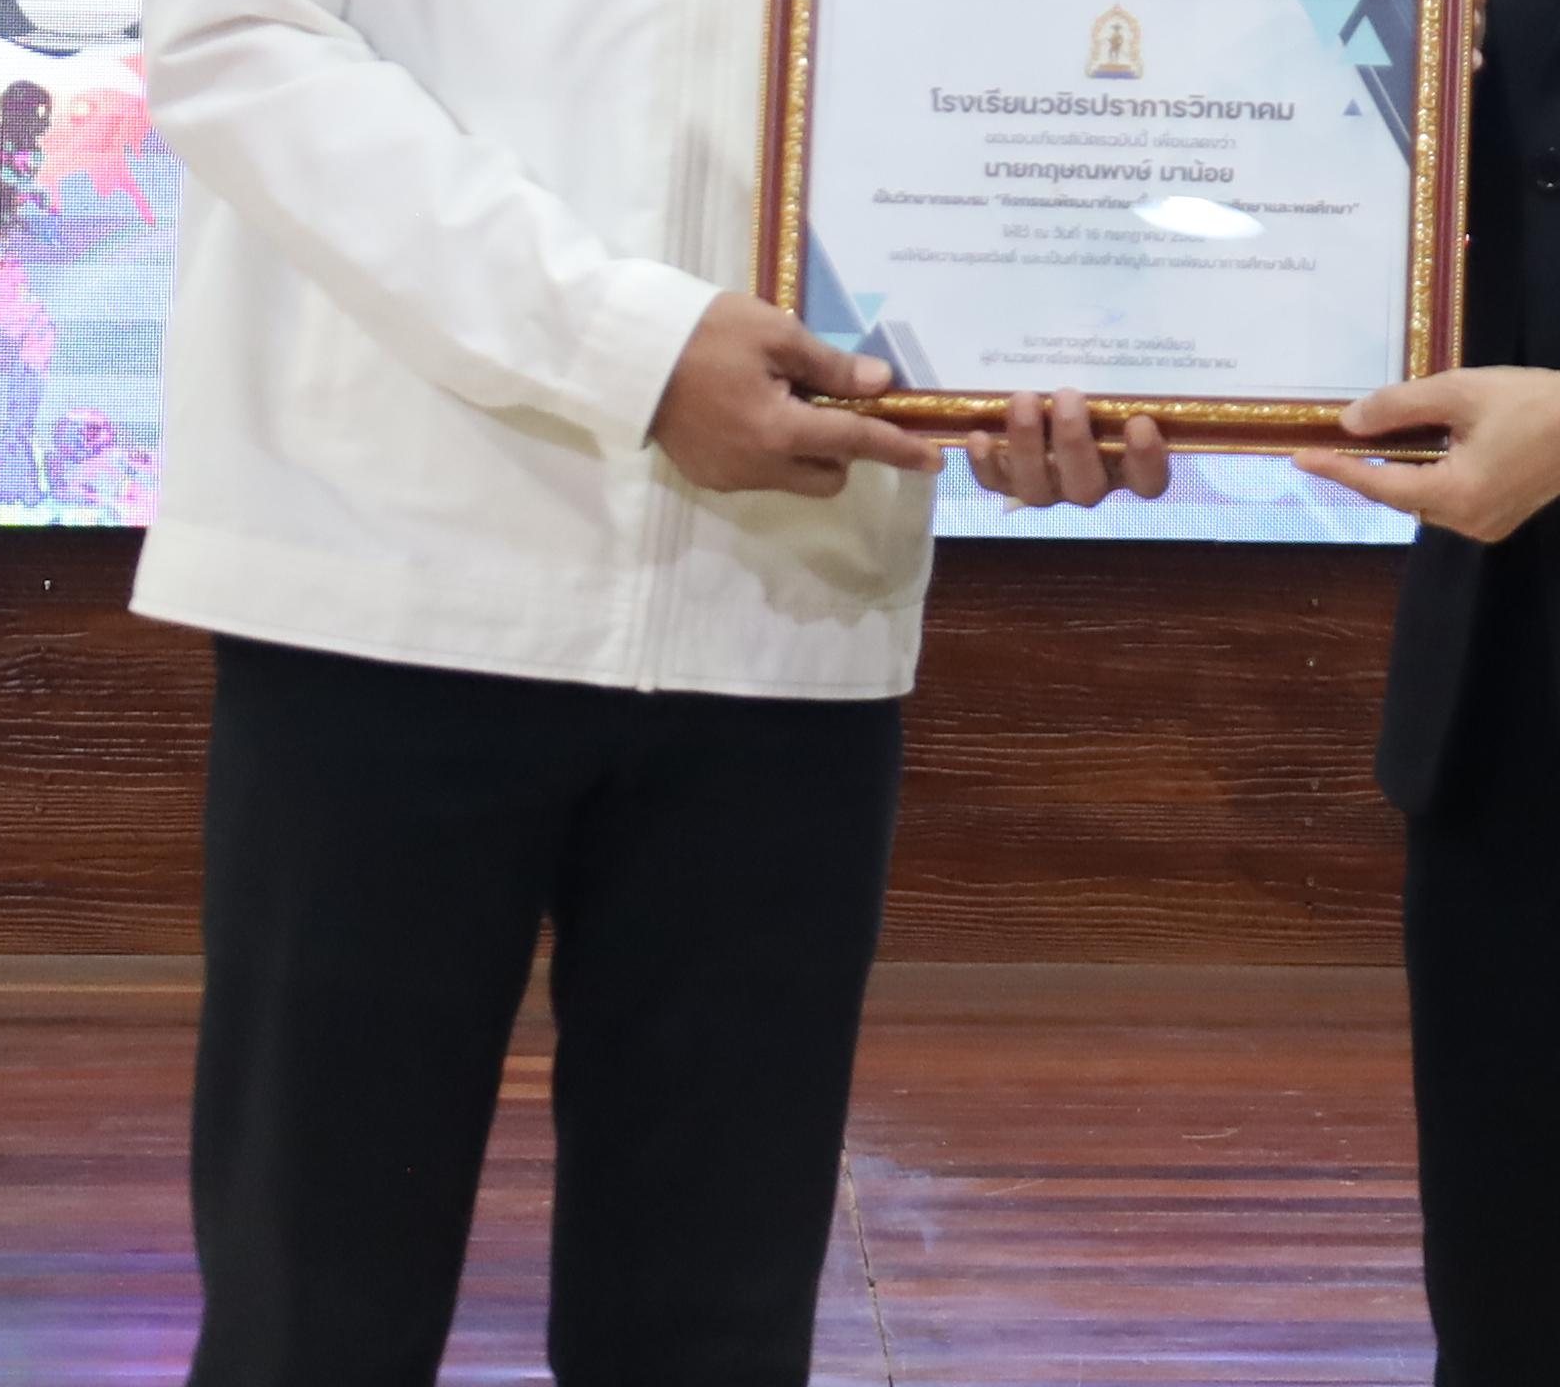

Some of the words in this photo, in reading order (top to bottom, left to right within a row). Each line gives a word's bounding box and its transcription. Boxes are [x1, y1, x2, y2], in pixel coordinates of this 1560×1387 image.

[930, 87, 1295, 121] โรงเรียนวชิรปราการวิทยาคม
